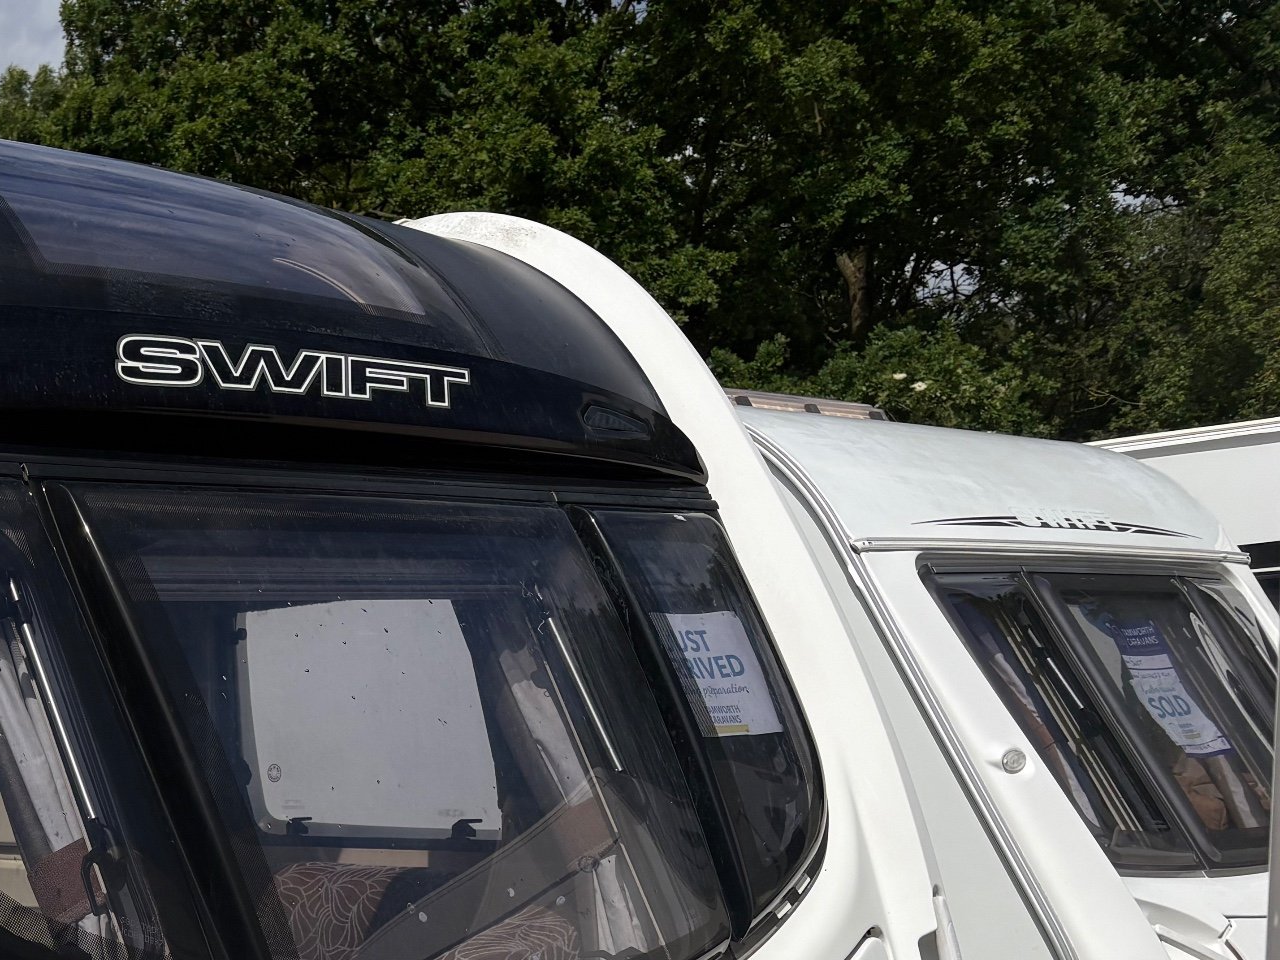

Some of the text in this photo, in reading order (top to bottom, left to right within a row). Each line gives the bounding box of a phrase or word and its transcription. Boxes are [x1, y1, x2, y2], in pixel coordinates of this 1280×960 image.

[115, 334, 470, 409] SWIFT
[1007, 506, 1118, 531] SWIFT
[677, 630, 710, 652] UST
[686, 655, 744, 679] RIVED
[1148, 695, 1191, 719] SOLD
[712, 714, 742, 725] ARAVANS
